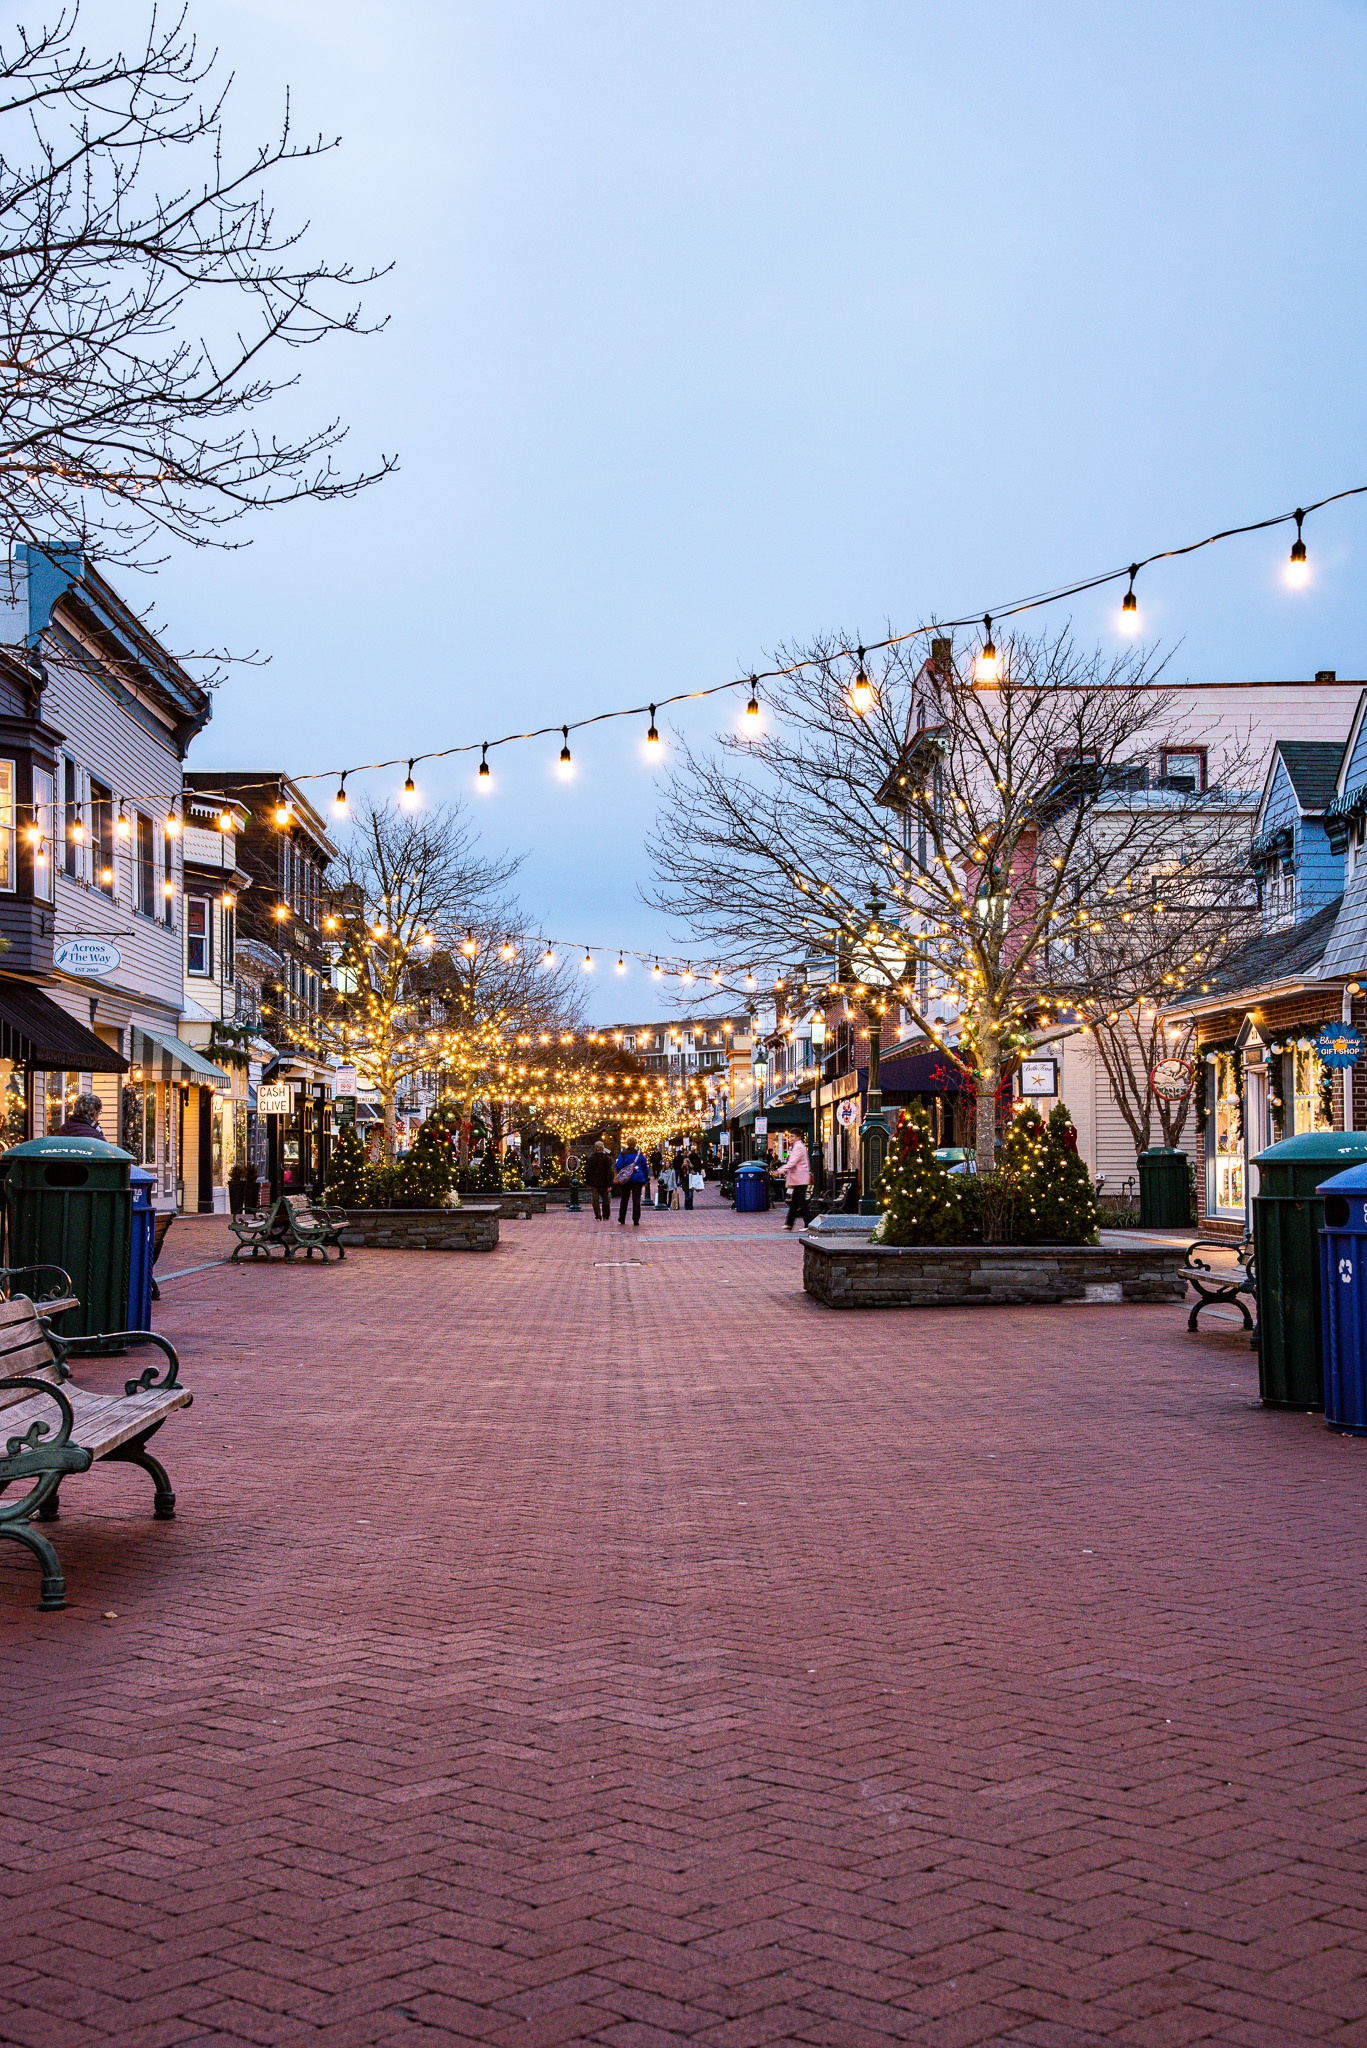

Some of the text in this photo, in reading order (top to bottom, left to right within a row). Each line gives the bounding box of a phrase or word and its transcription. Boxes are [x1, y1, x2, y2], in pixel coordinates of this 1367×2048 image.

[72, 943, 105, 952] Across
[69, 953, 111, 964] The Way
[1320, 1035, 1360, 1046] Blue Daisy
[259, 1087, 285, 1097] CASH
[259, 1101, 286, 1111] CLIVE
